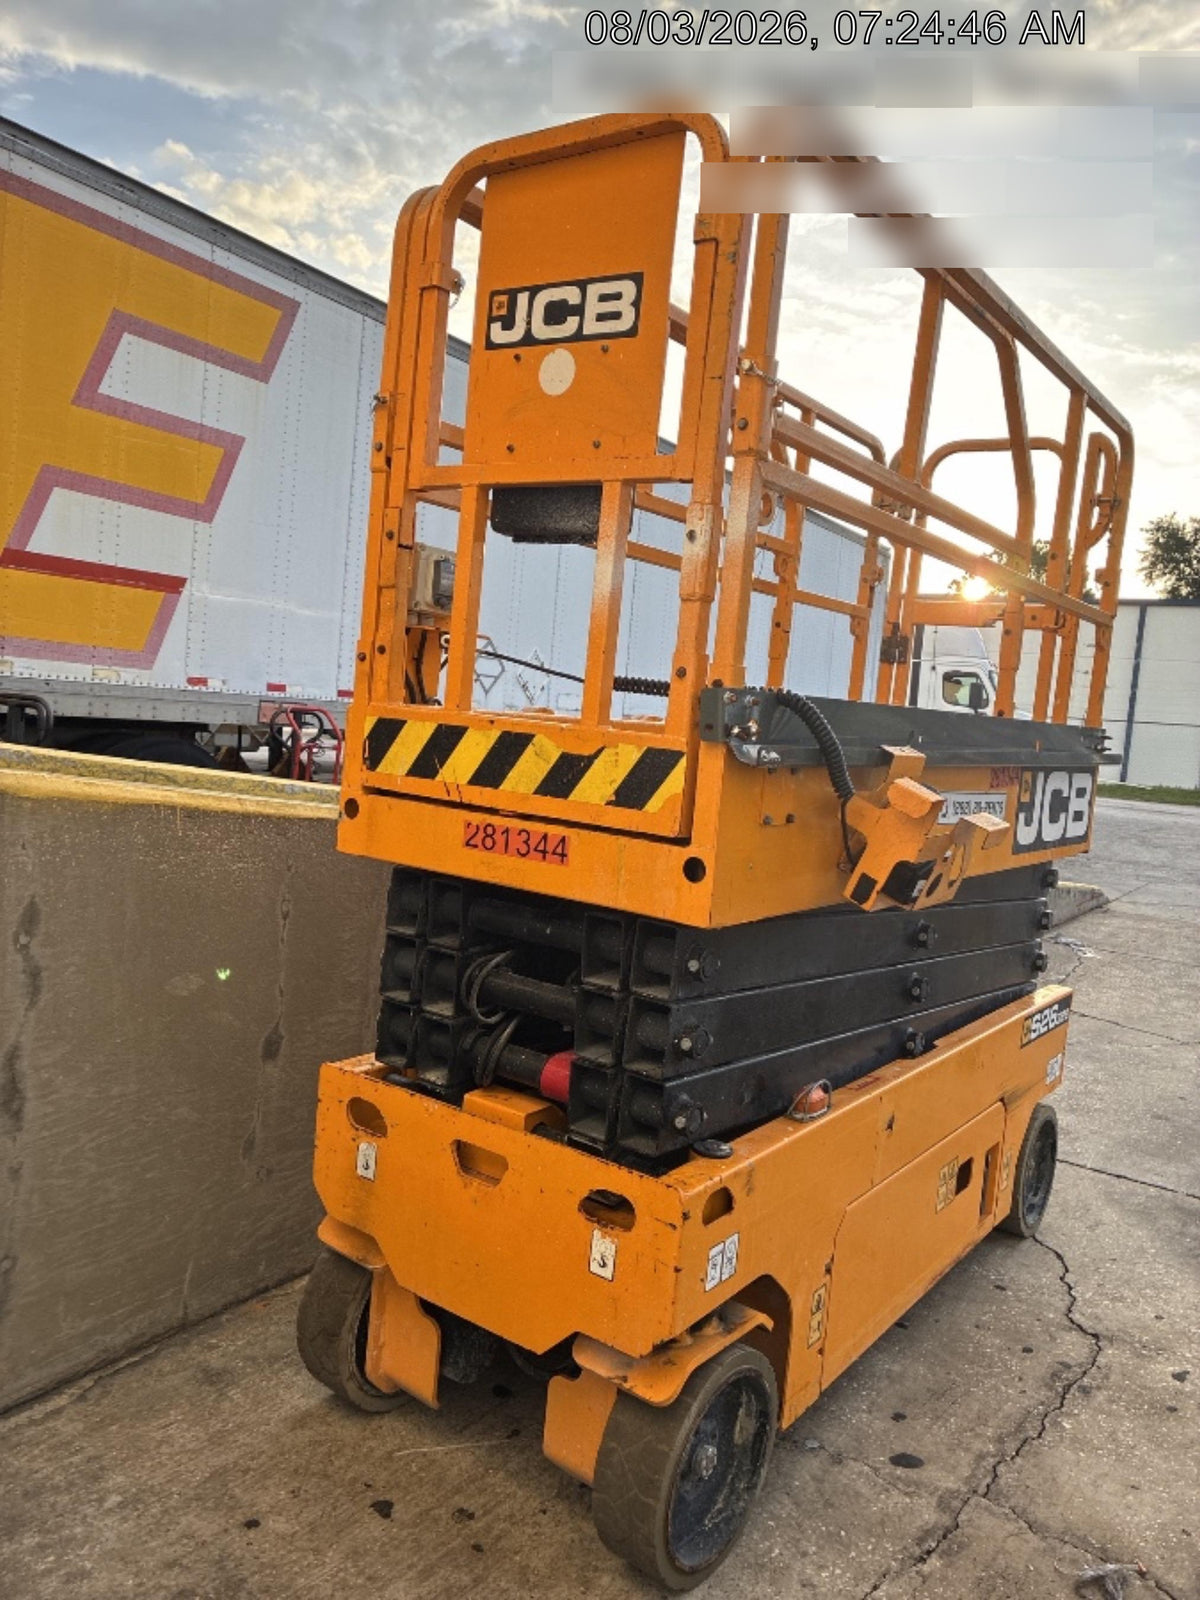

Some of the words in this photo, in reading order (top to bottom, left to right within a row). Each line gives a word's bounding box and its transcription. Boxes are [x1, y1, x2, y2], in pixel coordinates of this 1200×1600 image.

[490, 278, 638, 345] JCB
[1016, 770, 1093, 846] JCB
[464, 821, 569, 865] 281344
